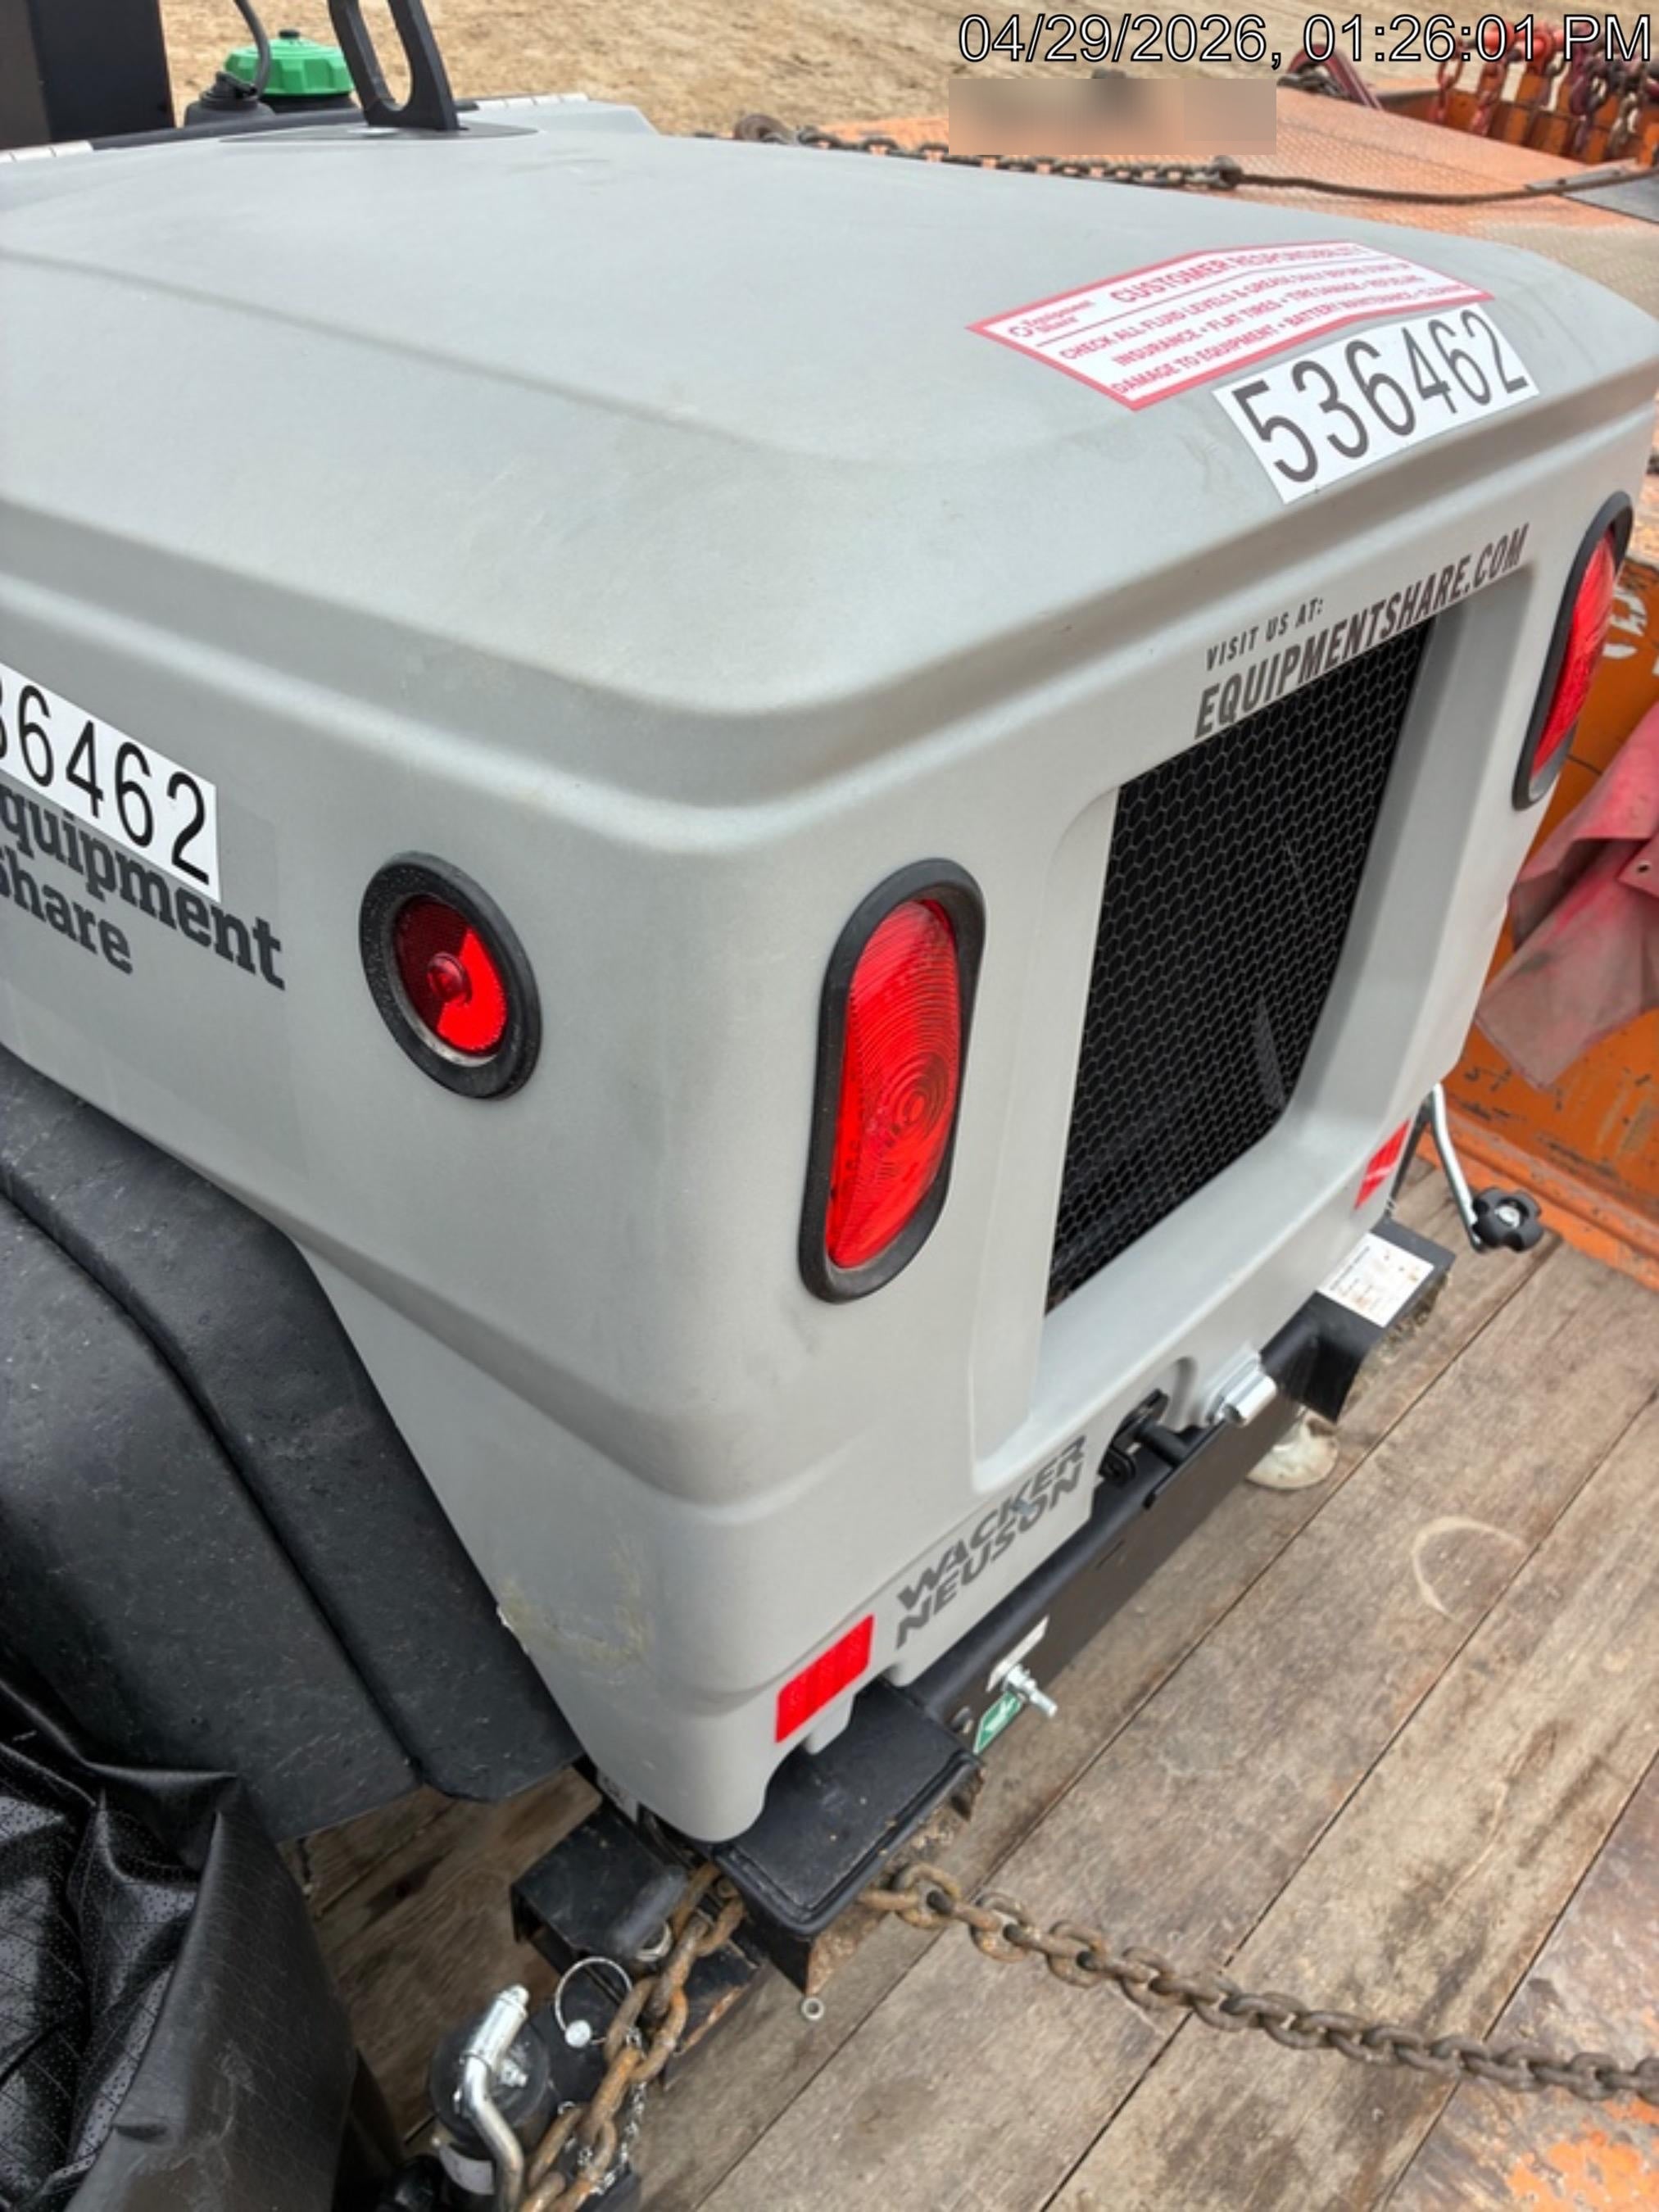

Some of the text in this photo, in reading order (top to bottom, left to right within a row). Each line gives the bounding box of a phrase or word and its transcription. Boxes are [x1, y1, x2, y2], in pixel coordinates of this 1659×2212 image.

[1059, 336, 1113, 360] CHECK
[1114, 325, 1146, 343] ALL
[1146, 310, 1187, 332] FLUID
[1188, 291, 1235, 315] LEVELS
[1110, 257, 1229, 302] CUSTOMER
[1110, 360, 1181, 394] DAMAGE
[1174, 353, 1200, 370] TO
[1195, 323, 1278, 361] EQUIPMENT
[1283, 299, 1339, 329] BATTERY
[1112, 328, 1203, 367] INSURANCE
[1205, 311, 1240, 333] FLAT
[1240, 299, 1282, 320] TIRES
[1231, 309, 1529, 483] 536462
[1194, 522, 1530, 738] EQUIPMENTSHARE.COM
[1207, 597, 1324, 671] VISIT US AT:
[0, 675, 211, 886] 6462
[895, 1462, 1085, 1650] NEUSON
[896, 1435, 1086, 1611] WACKER
